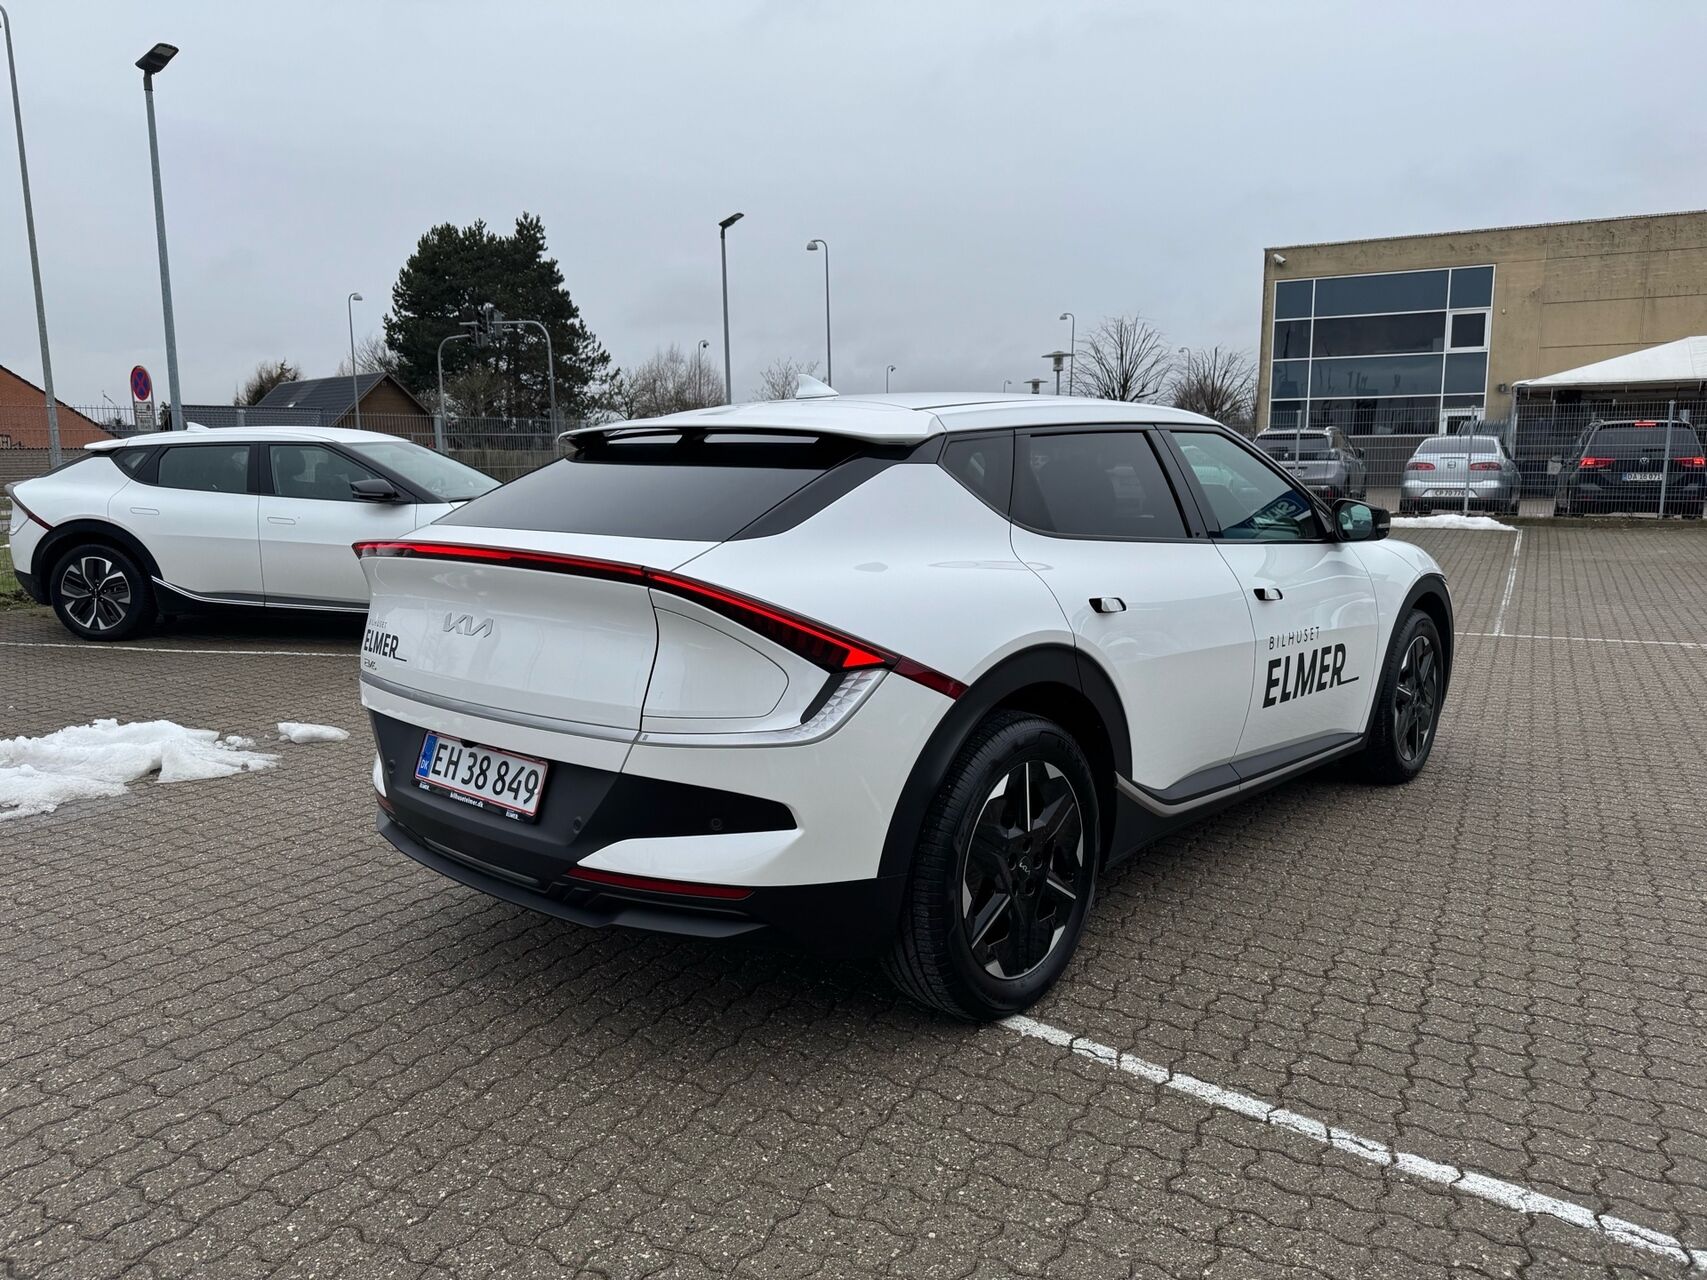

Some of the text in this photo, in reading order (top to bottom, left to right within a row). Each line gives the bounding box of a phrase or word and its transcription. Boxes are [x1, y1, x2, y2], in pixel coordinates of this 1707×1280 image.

[443, 612, 494, 639] KIA
[1269, 626, 1320, 650] BILHUSET
[364, 628, 407, 662] ELMER
[1262, 643, 1359, 709] ELMER
[420, 759, 430, 770] DK
[431, 743, 539, 804] EH 38 849
